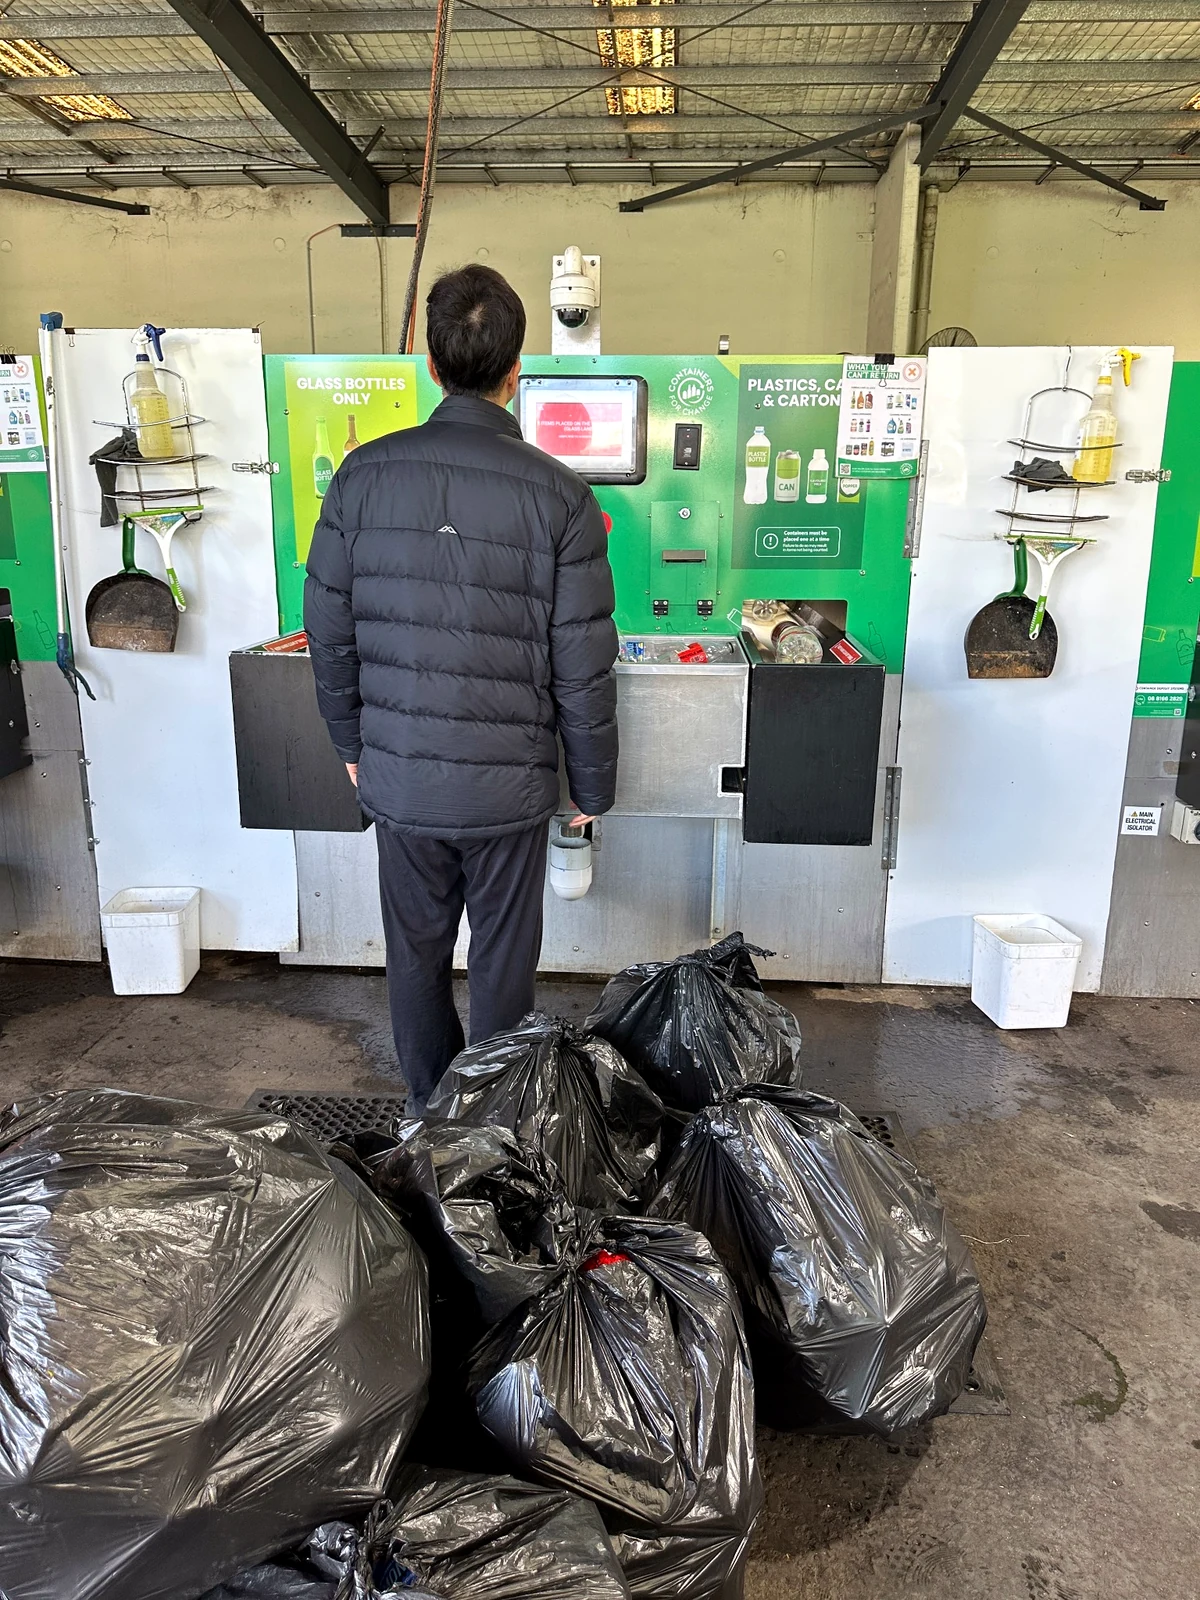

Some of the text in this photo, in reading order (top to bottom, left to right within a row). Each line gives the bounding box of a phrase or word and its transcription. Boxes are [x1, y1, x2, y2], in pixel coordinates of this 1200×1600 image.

[296, 377, 406, 390] GLASS BOTTLES
[668, 367, 714, 393] CONTAINERS
[748, 379, 821, 393] PLASTICS,
[332, 393, 371, 405] ONLY
[669, 395, 713, 415] FOR CHANGE
[763, 394, 774, 407] &
[778, 483, 795, 491] CAN
